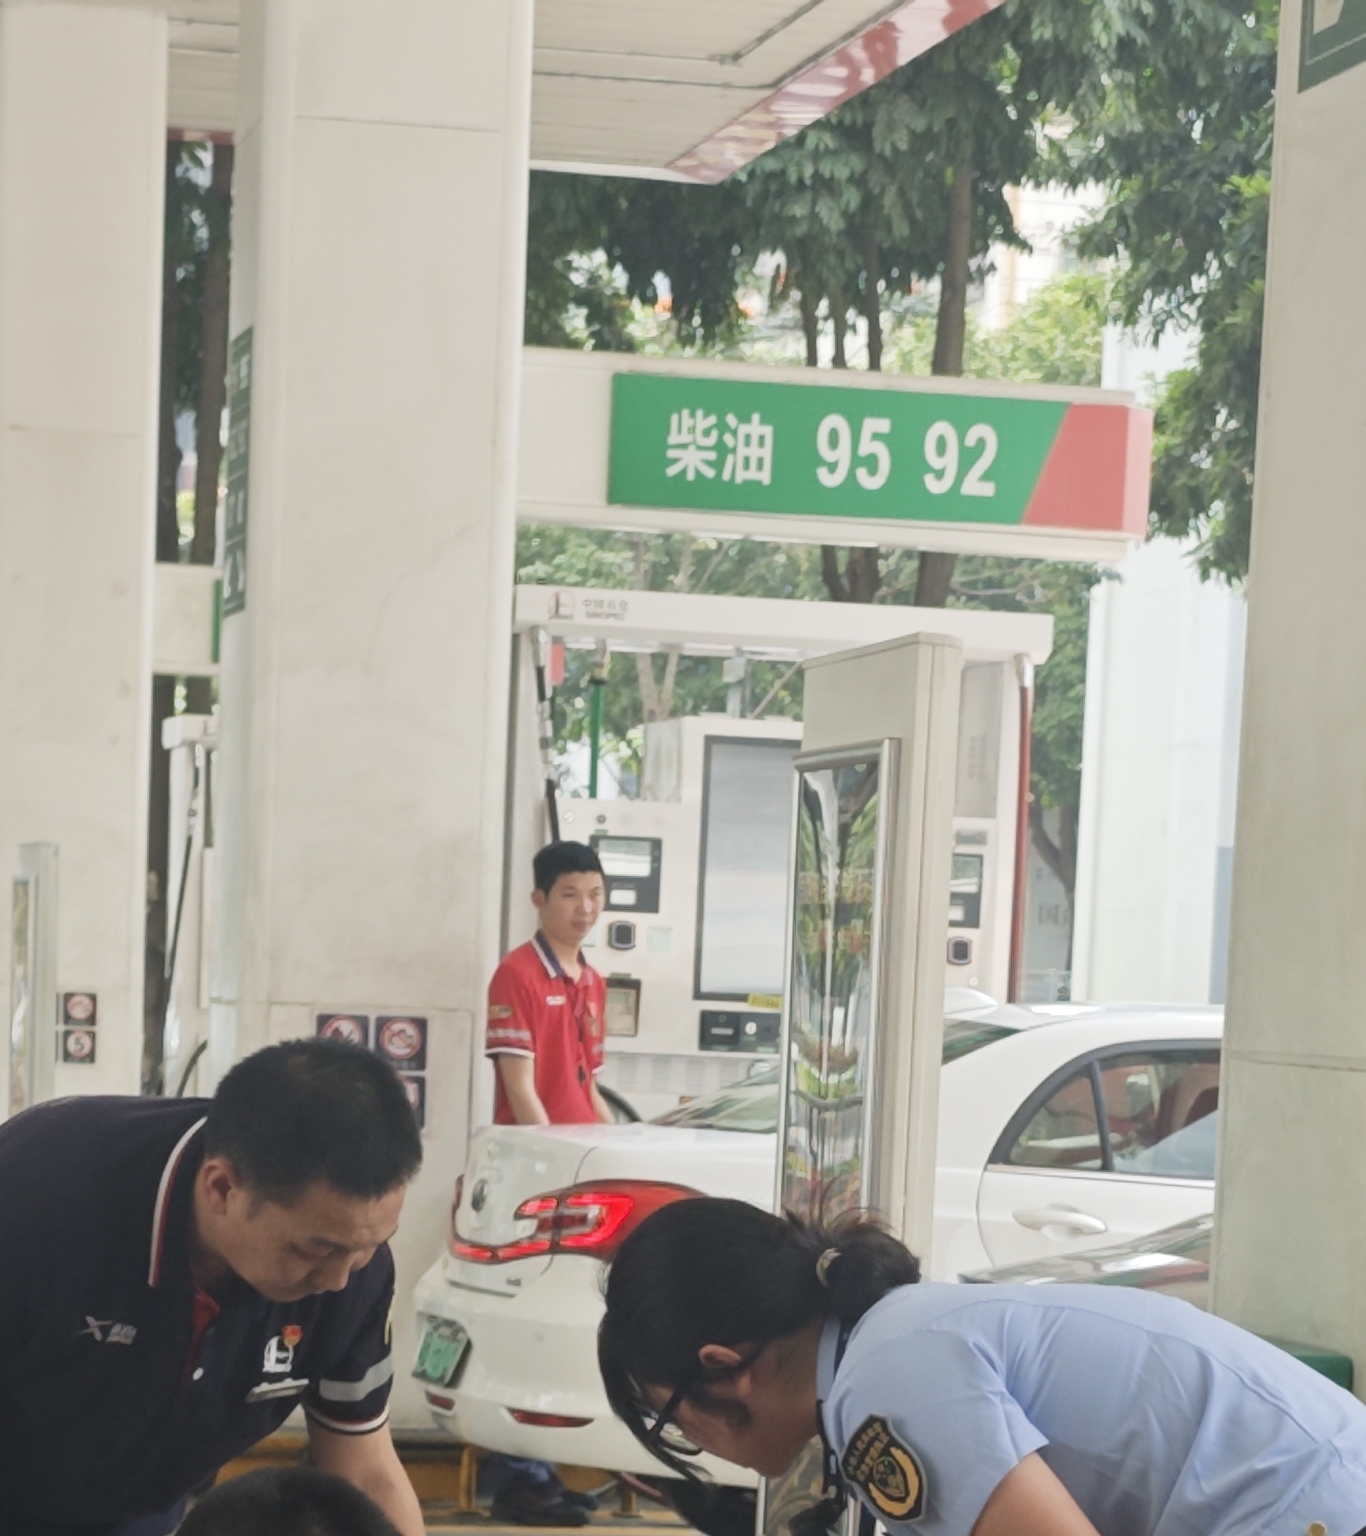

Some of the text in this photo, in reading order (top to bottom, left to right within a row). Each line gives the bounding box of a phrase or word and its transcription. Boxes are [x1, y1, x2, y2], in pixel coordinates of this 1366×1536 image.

[665, 408, 998, 497] 柴油 95 92
